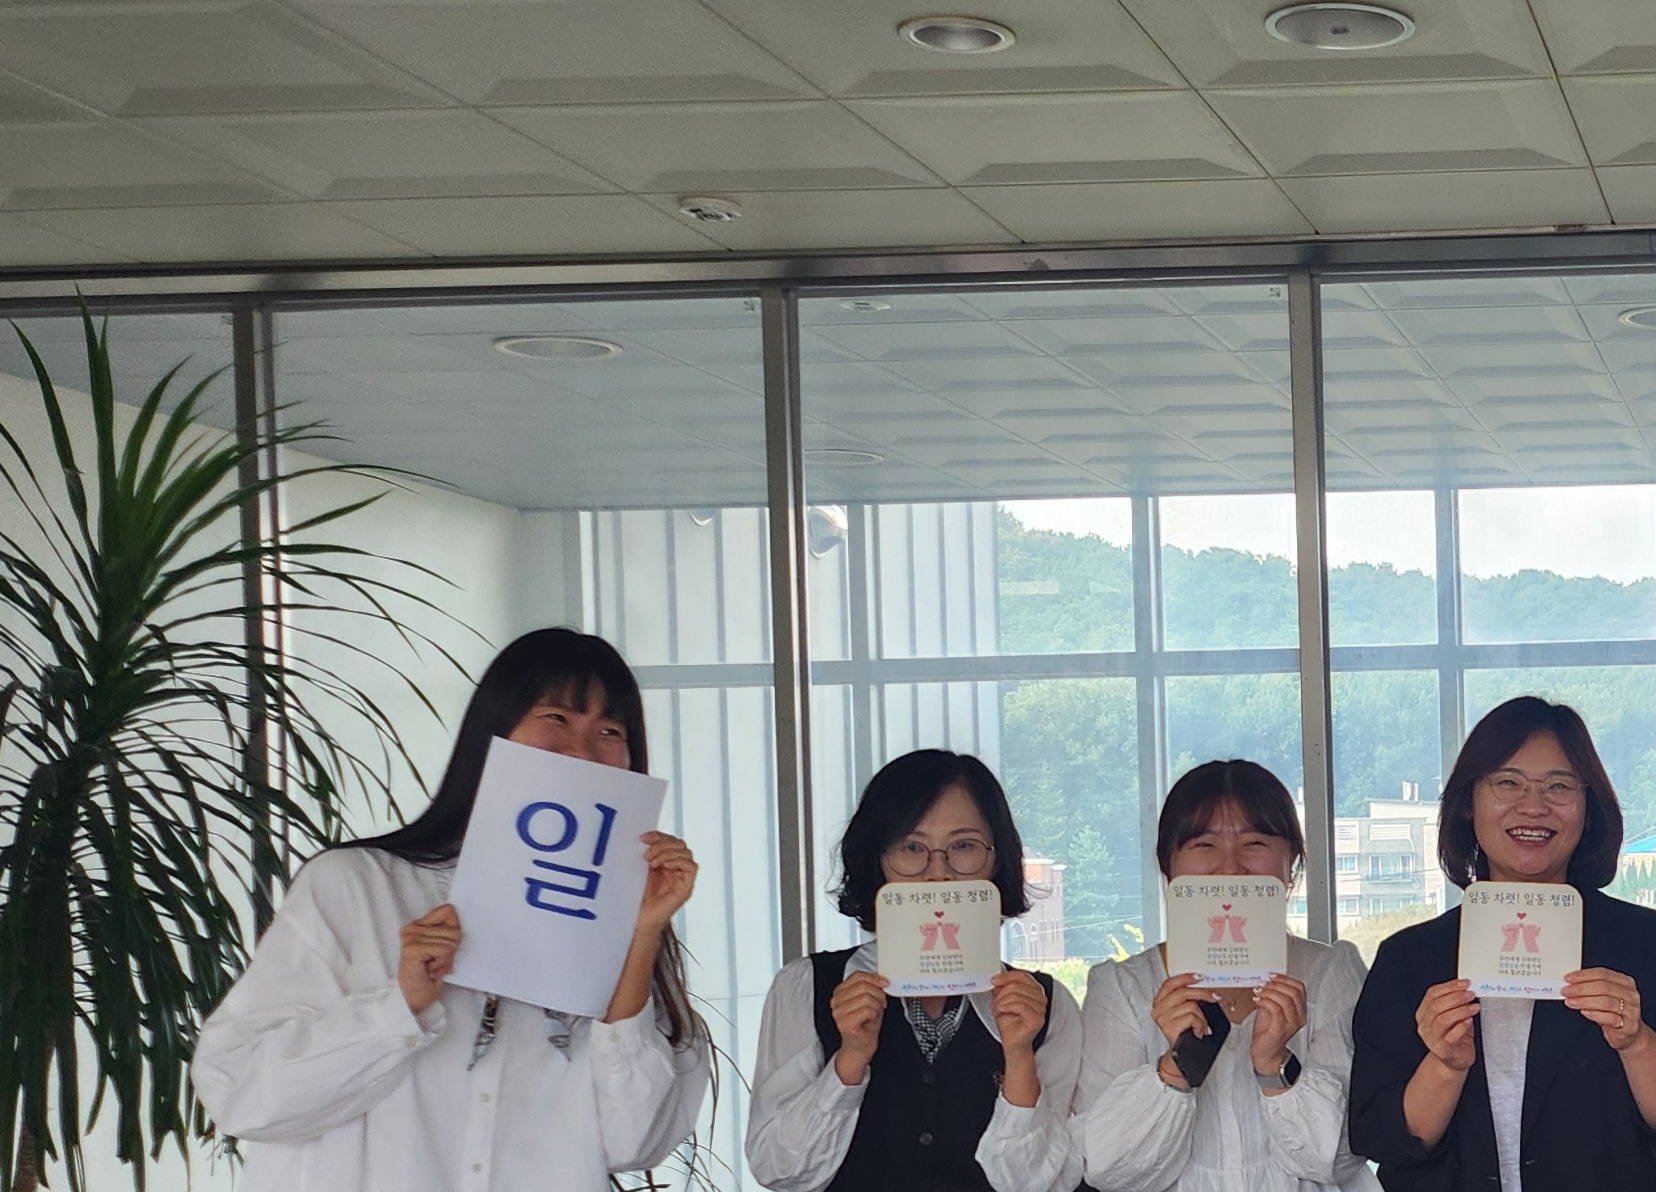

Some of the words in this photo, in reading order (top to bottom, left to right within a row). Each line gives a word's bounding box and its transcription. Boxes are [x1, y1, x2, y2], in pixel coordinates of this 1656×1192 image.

[516, 801, 617, 920] 일
[882, 894, 905, 905] 일동
[909, 893, 937, 904] 차렷!
[941, 892, 963, 903] 일동
[967, 890, 993, 902] 청렴!
[1173, 885, 1195, 897] 일동
[1198, 886, 1224, 897] 차렷!
[1229, 886, 1251, 897] 일동
[1255, 885, 1279, 897] 청렴!
[1469, 892, 1490, 904] 일동
[1494, 893, 1520, 905] 차렷!
[1524, 893, 1546, 906] 일동
[1550, 894, 1575, 906] 청렴!
